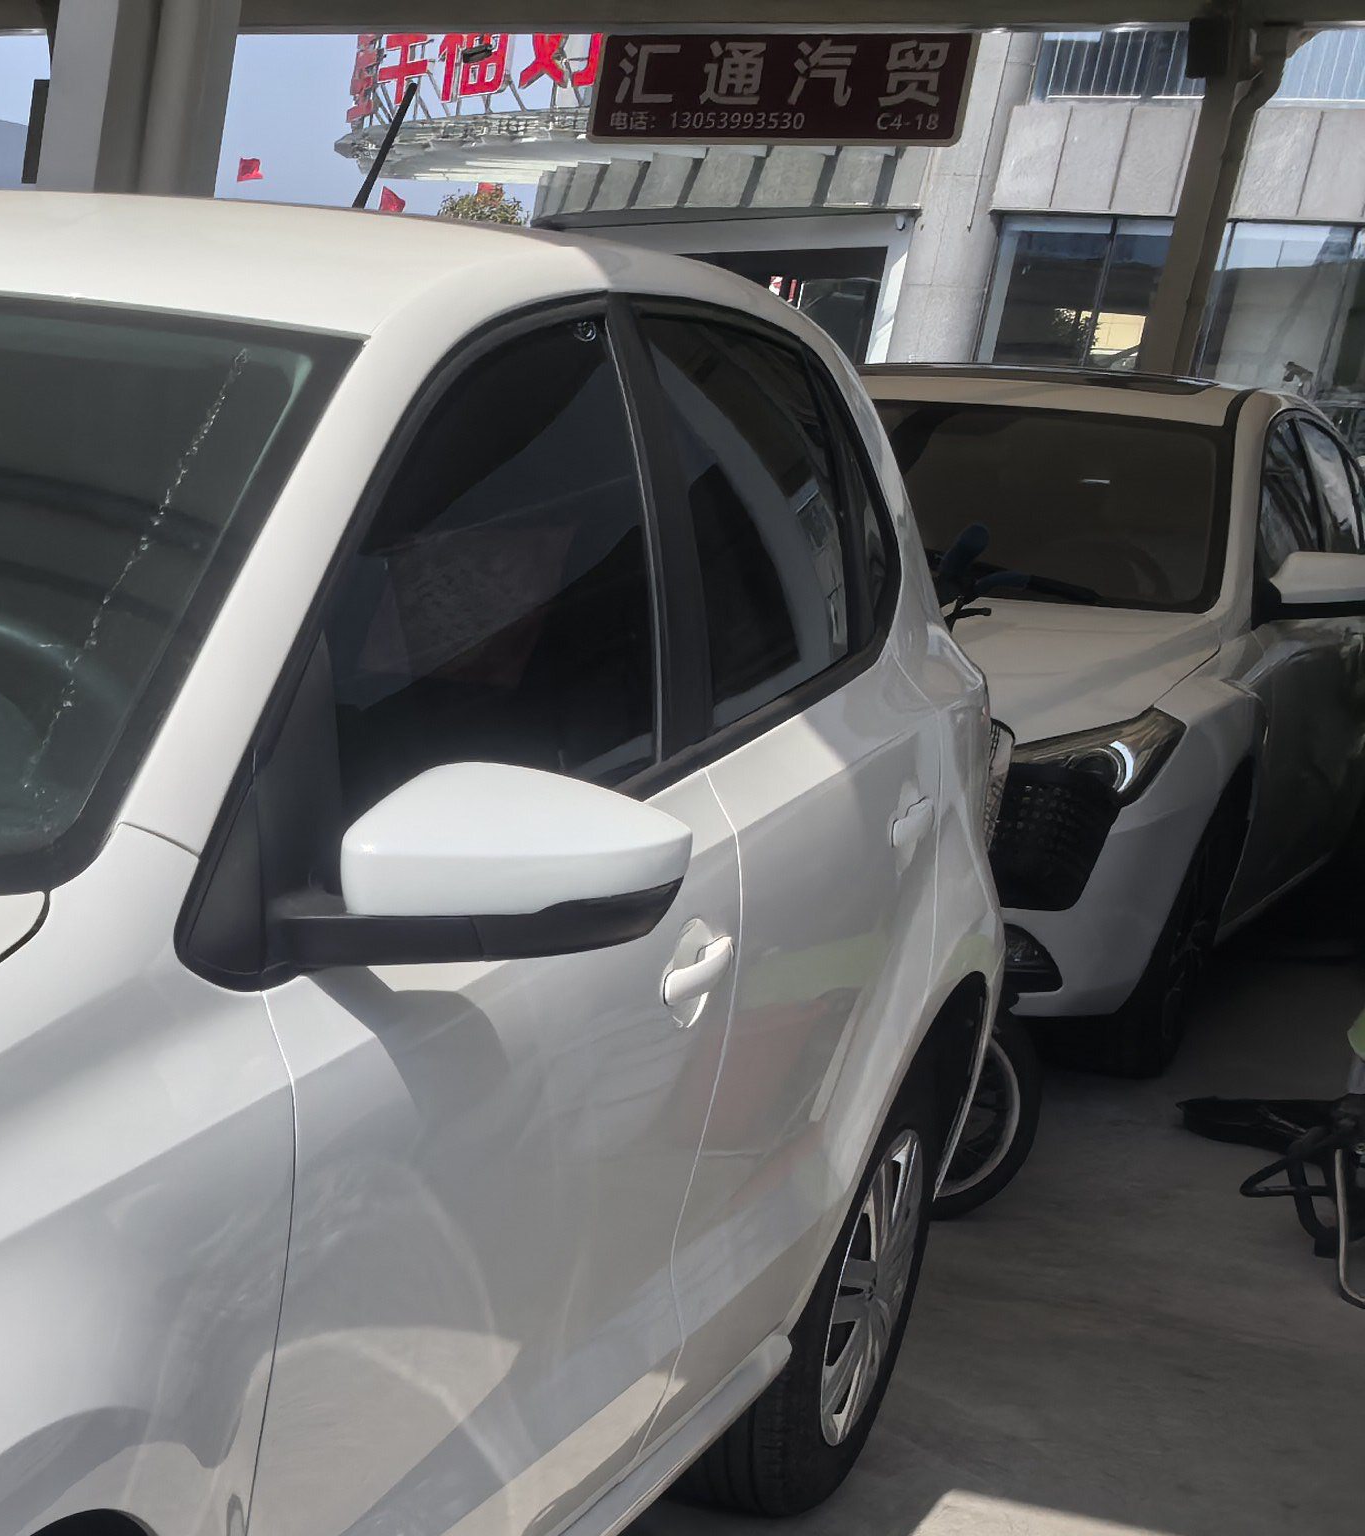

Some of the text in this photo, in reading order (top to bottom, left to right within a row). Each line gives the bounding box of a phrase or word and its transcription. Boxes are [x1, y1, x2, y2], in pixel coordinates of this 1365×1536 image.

[614, 39, 951, 108] 汇通汽贸
[670, 111, 806, 131] 13053993530
[876, 111, 939, 131] C4-18
